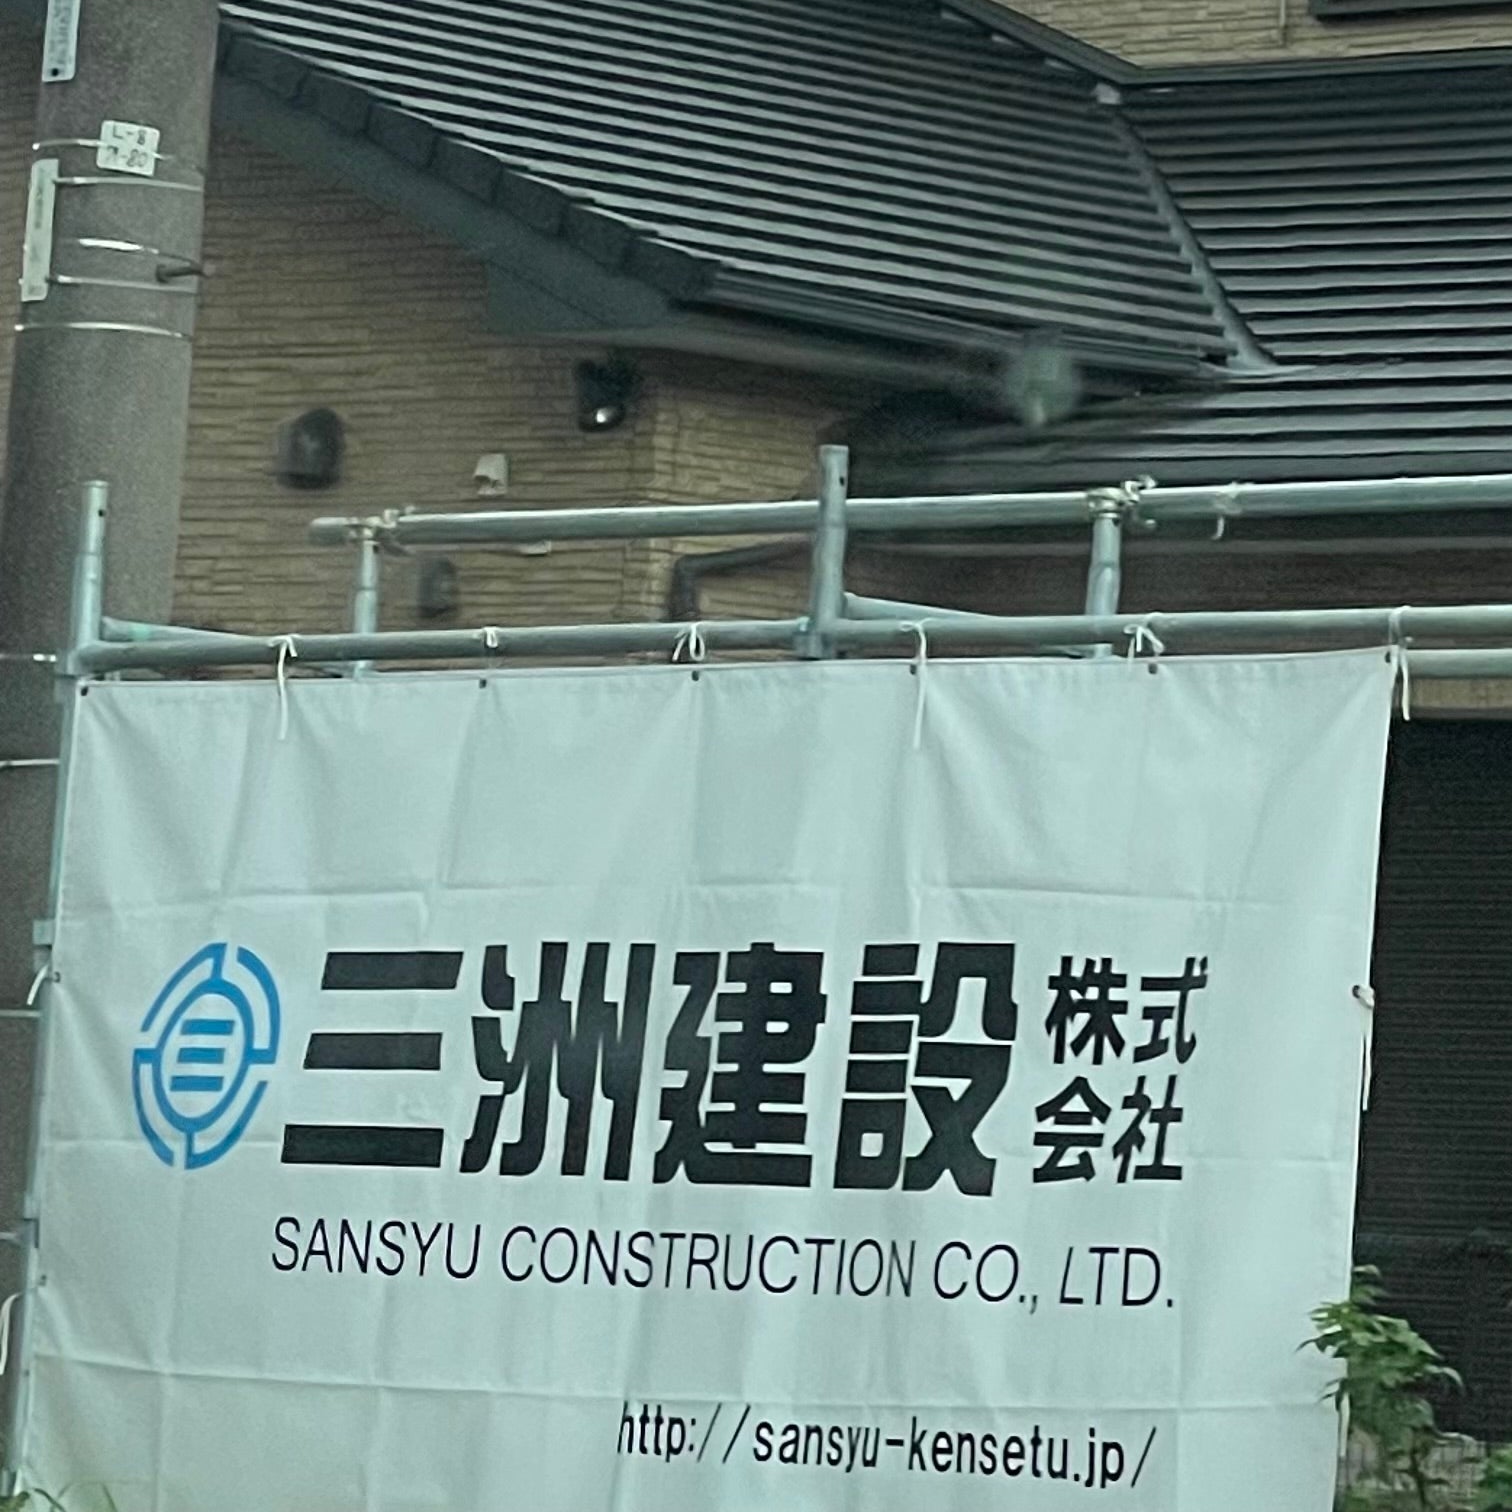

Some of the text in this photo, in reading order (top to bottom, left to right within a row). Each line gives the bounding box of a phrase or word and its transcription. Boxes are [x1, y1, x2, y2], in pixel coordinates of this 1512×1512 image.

[1044, 955, 1208, 1066] 株式
[280, 941, 1019, 1197] 三洲建設
[1032, 1074, 1184, 1184] 会社
[272, 1216, 1173, 1314] SANSYU CONSTRUCTION CO., LTD.
[616, 1400, 1157, 1489] http://sansyu-kensetu.jp/
